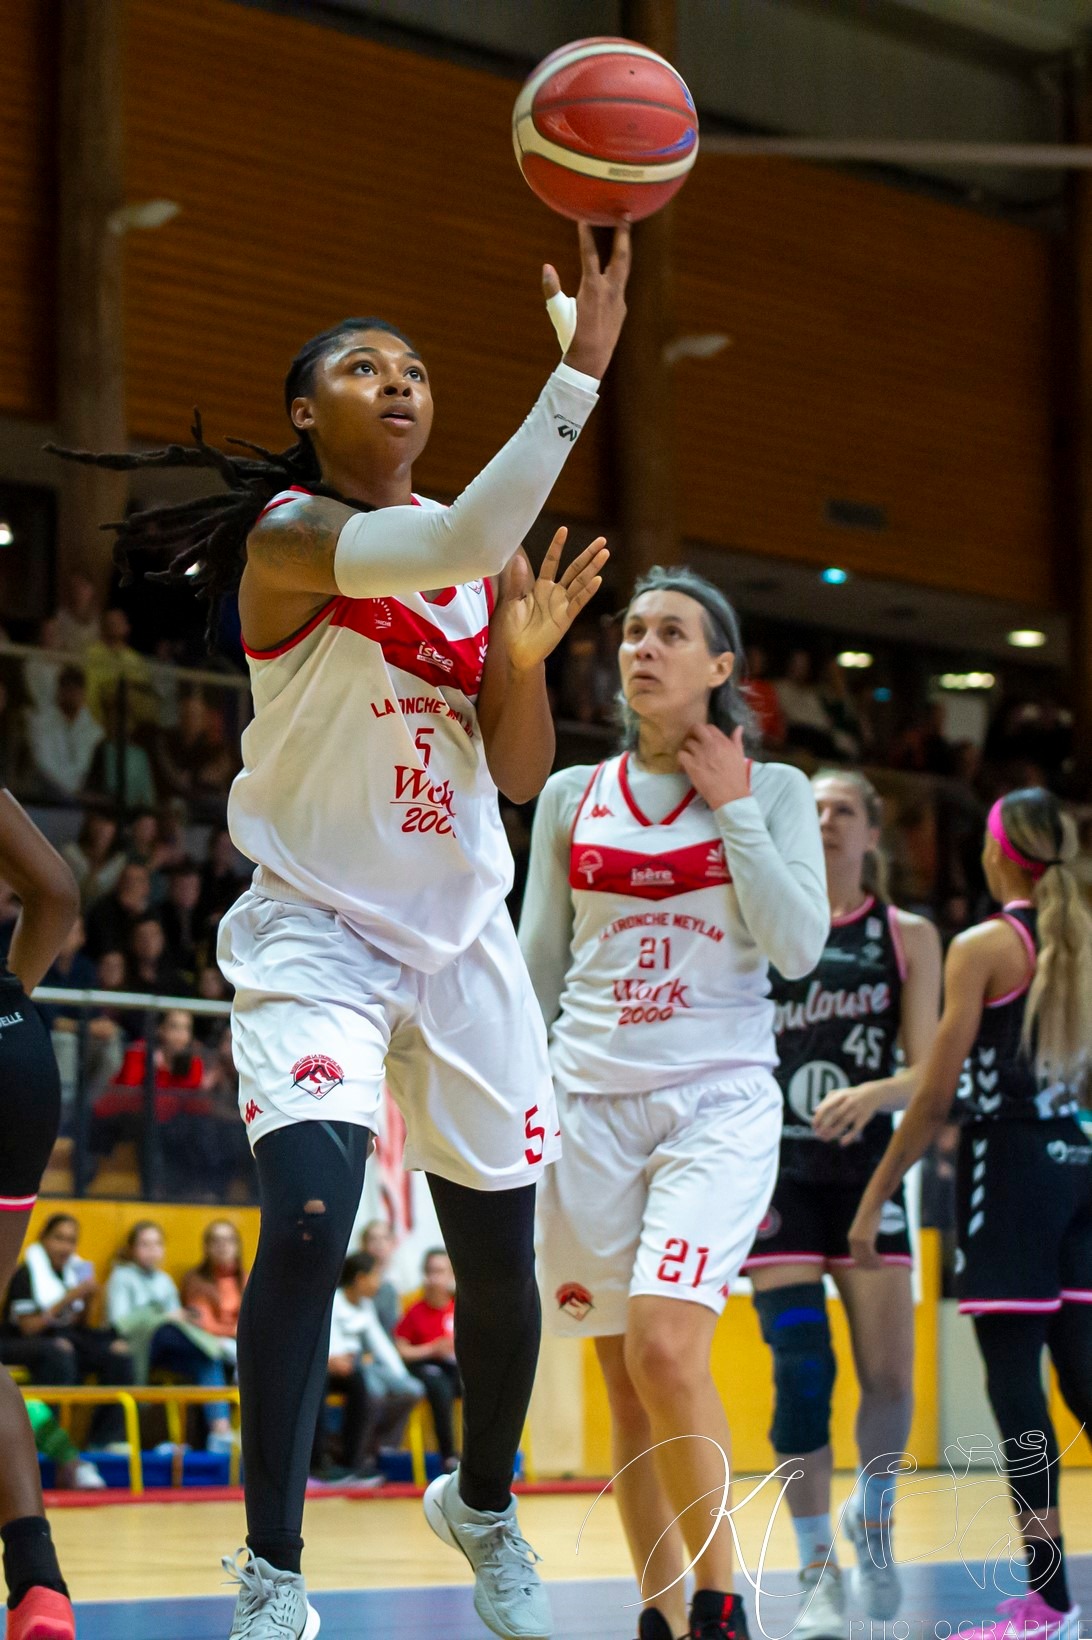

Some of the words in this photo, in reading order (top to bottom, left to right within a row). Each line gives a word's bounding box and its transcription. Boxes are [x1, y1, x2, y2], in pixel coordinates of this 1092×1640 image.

[370, 699, 396, 718] LA
[415, 728, 434, 768] 5
[631, 867, 673, 880] isère
[673, 914, 725, 942] MEYLAN
[639, 937, 670, 970] 21
[612, 978, 692, 1008] Work
[618, 1006, 674, 1025] 2000
[842, 1023, 886, 1069] 45
[524, 1104, 545, 1165] 5
[657, 1238, 709, 1288] 21
